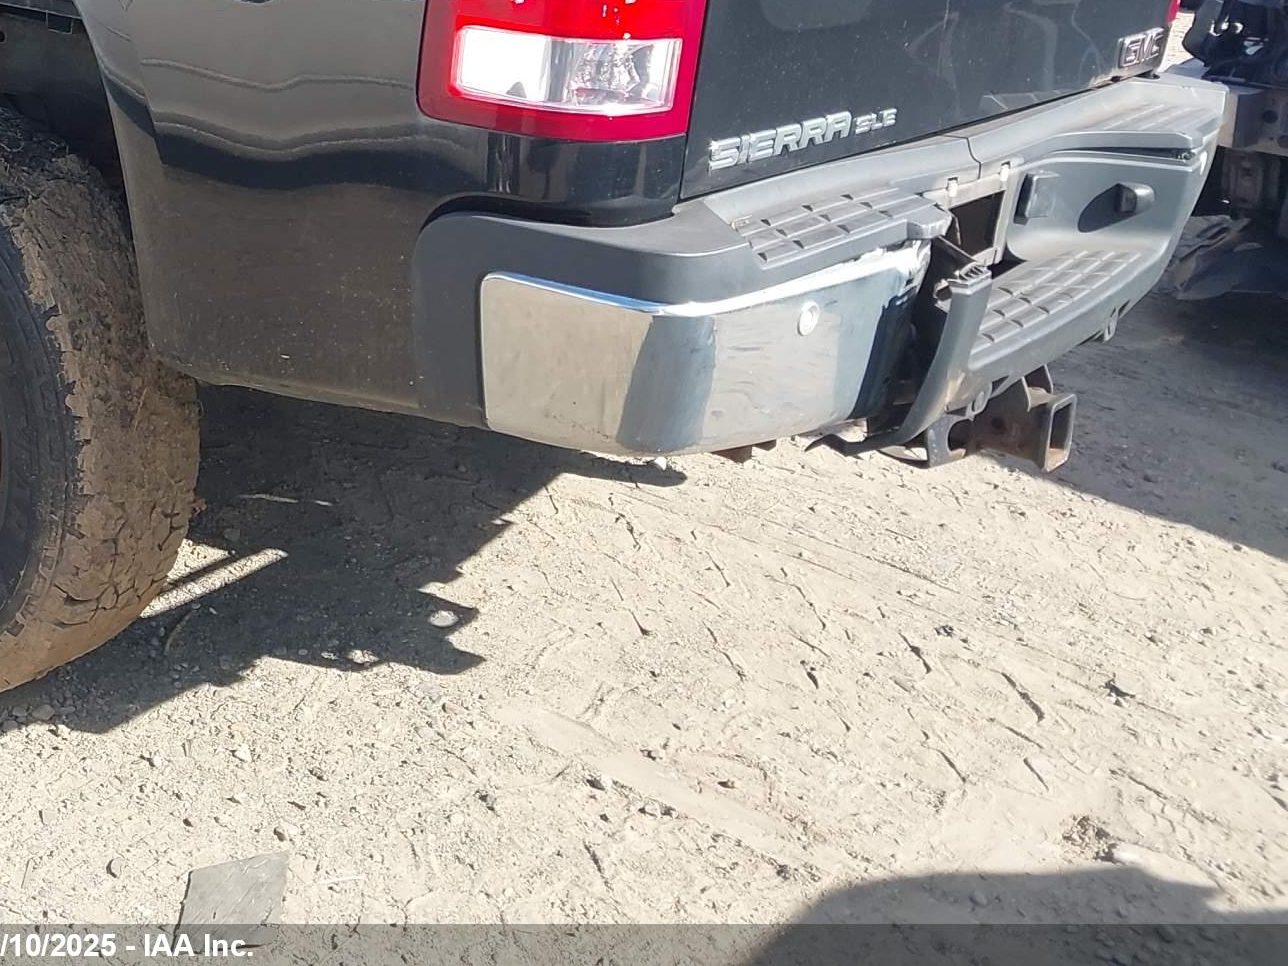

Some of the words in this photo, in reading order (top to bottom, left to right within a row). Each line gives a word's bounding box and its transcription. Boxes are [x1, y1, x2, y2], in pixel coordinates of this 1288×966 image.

[1119, 32, 1164, 67] GMC
[709, 111, 852, 172] SIERRA
[855, 108, 897, 134] SLE
